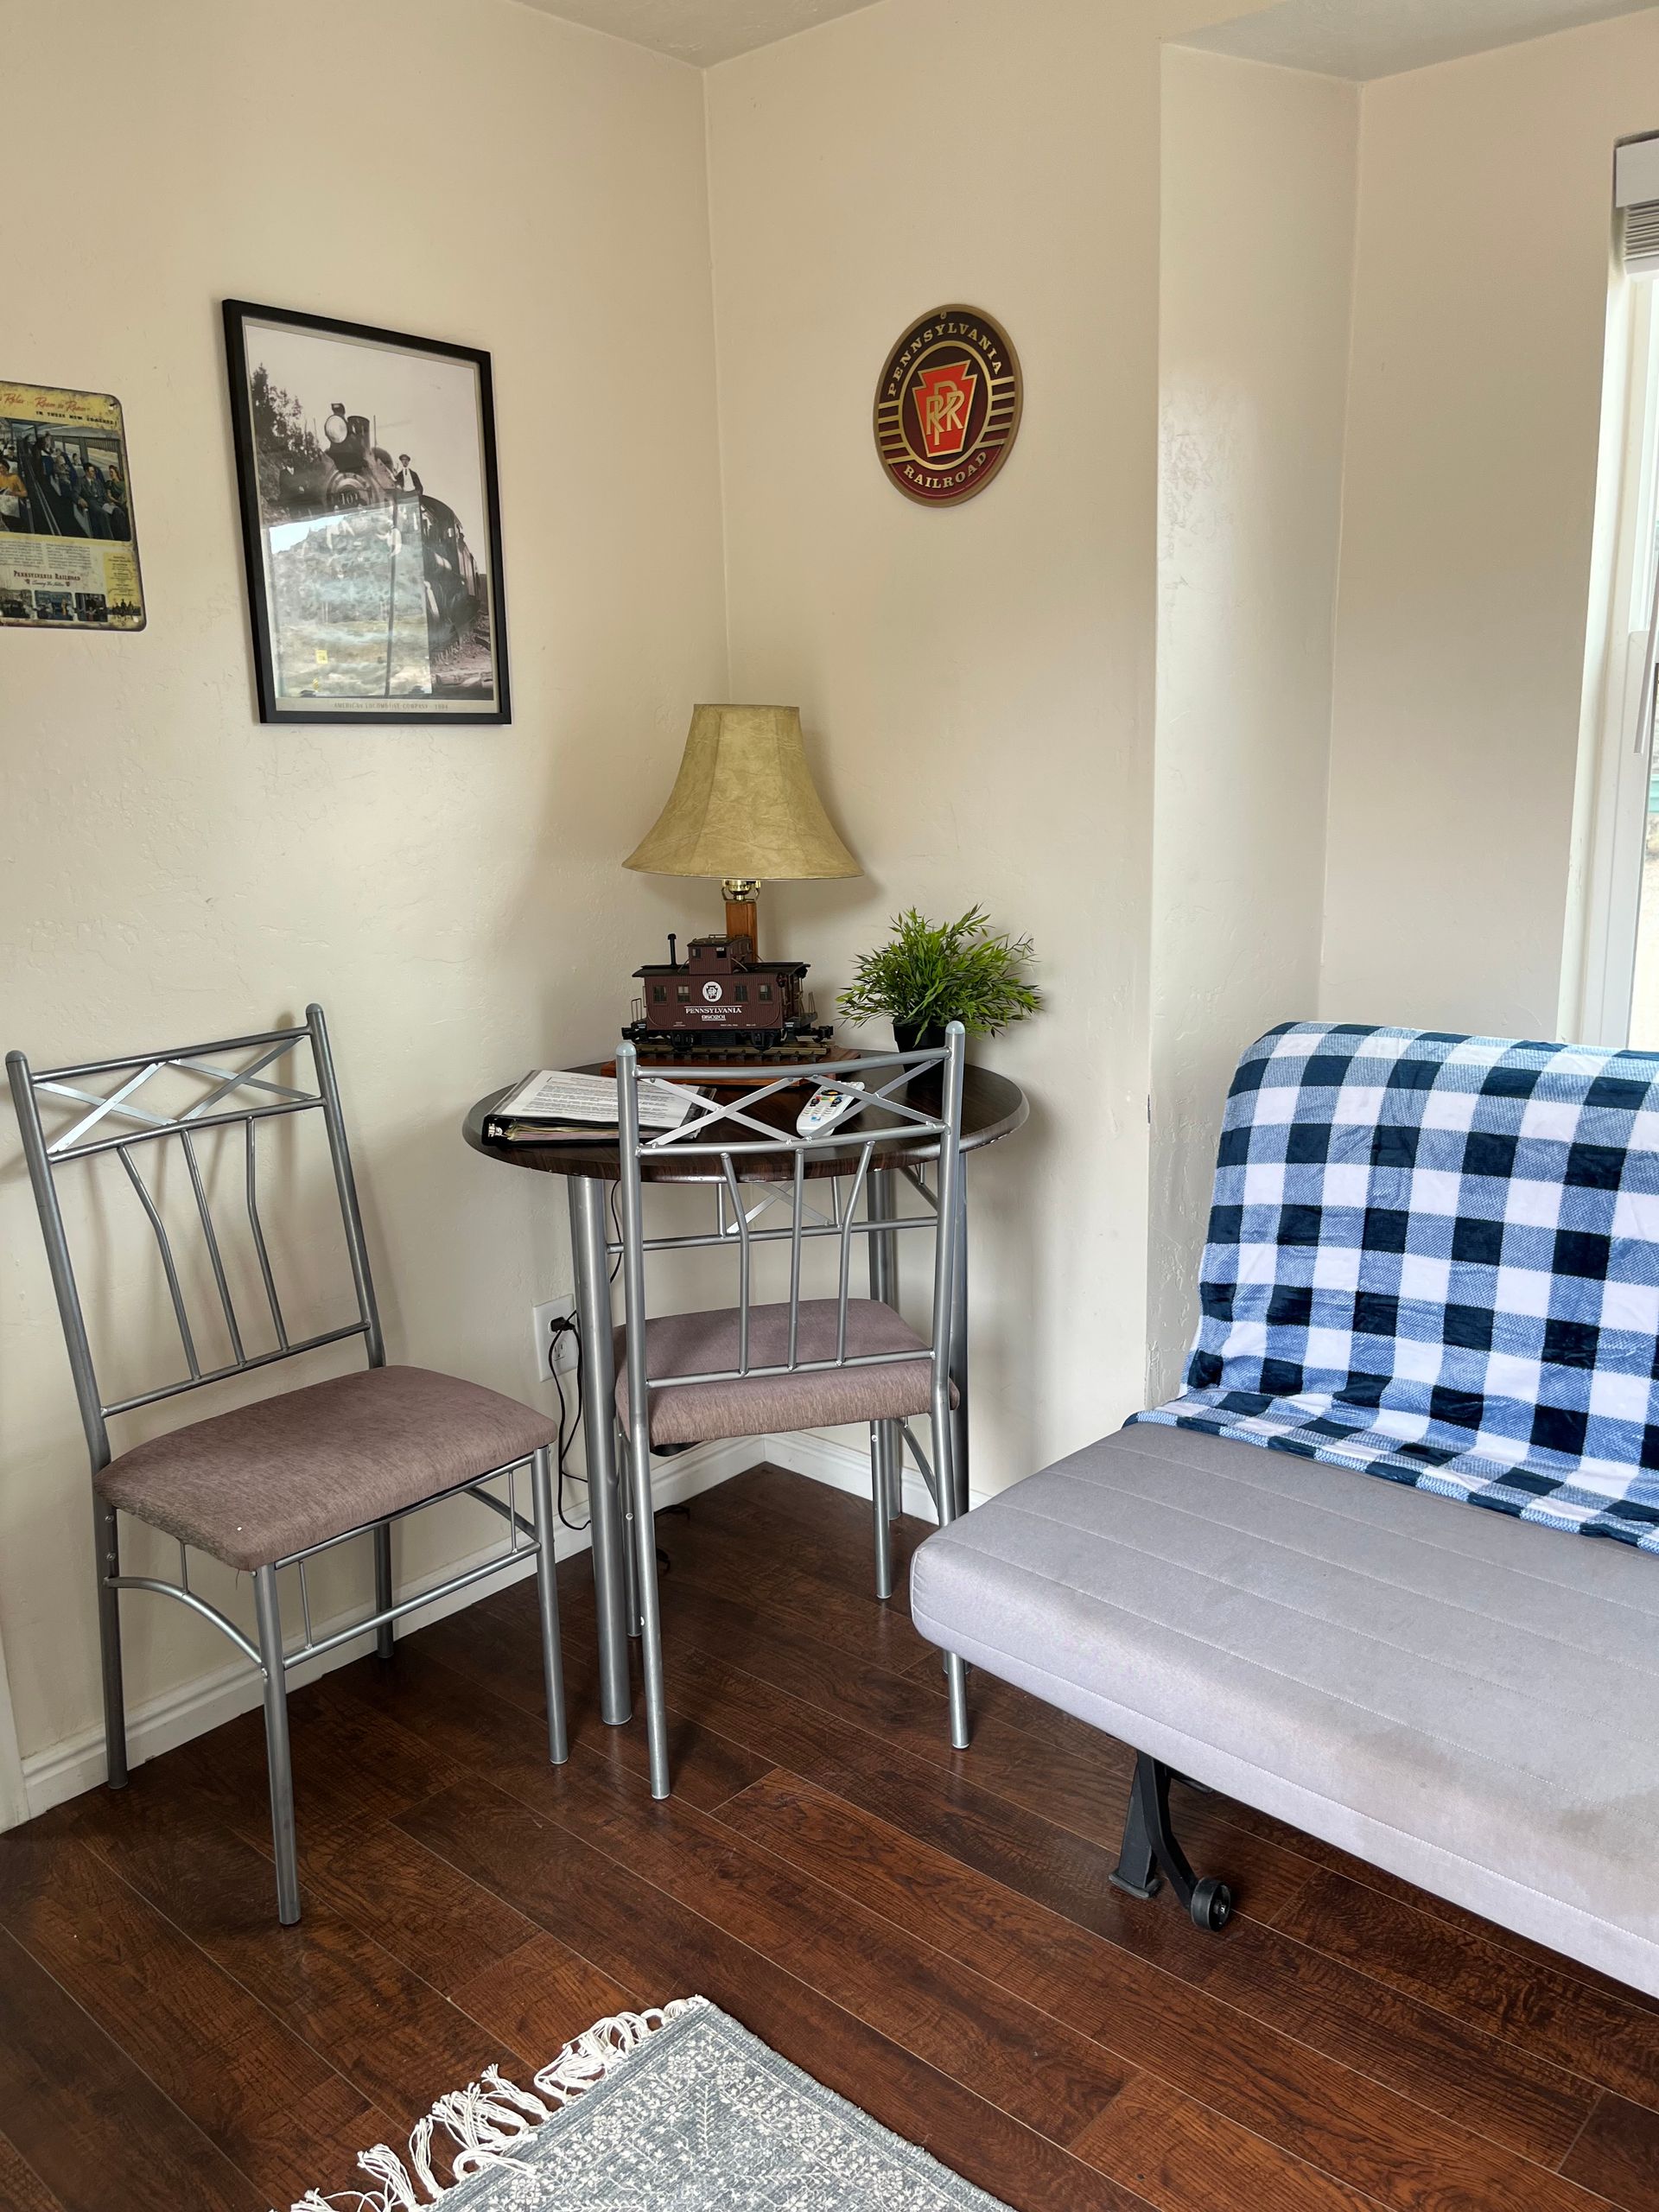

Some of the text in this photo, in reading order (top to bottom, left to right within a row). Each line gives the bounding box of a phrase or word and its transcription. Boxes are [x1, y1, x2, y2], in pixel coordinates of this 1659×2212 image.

[887, 322, 1002, 397] PENNSYLVANIA
[903, 451, 987, 489] RAILROAD
[13, 570, 81, 582] PENNSYLVANIA RAILROAD
